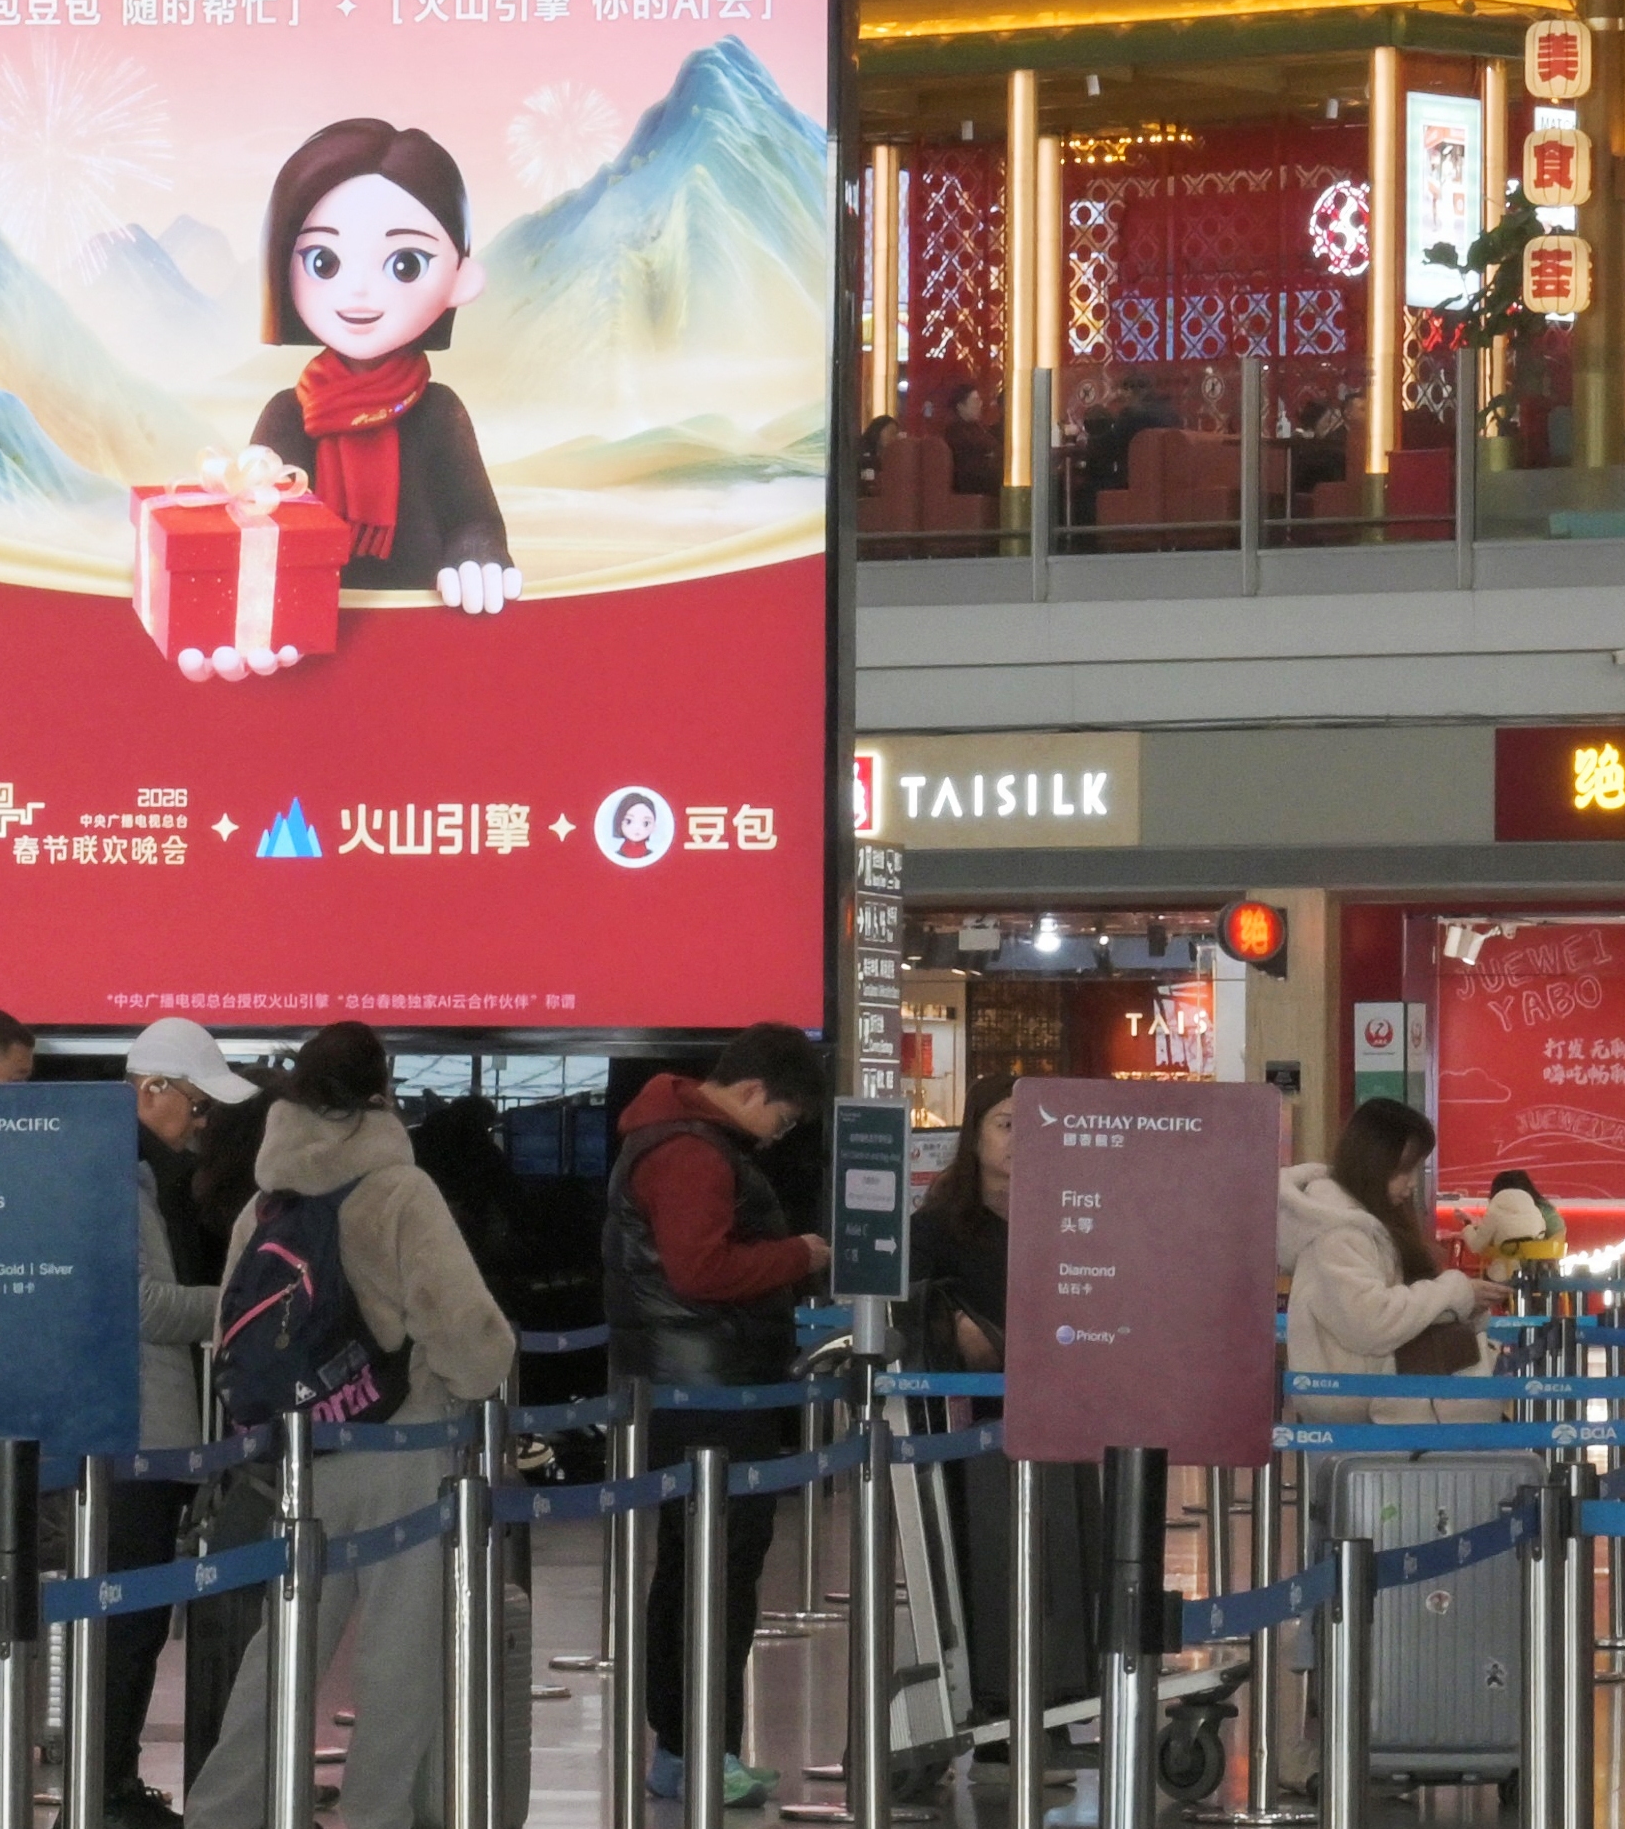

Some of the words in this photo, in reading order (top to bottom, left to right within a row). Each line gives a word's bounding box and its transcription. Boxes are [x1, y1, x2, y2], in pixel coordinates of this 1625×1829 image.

[138, 789, 187, 807] 2026
[900, 772, 1108, 819] TAISILK
[339, 804, 529, 854] 火山引擎
[684, 804, 777, 850] 豆包
[13, 835, 187, 864] 春节联欢晚会
[1456, 929, 1613, 1001] JUEWEI
[1488, 974, 1603, 1032] YABO
[1063, 1114, 1133, 1130] CATHAY
[1137, 1116, 1202, 1132] PACIFIC
[1061, 1190, 1101, 1208] First
[39, 1262, 74, 1276] Silver
[1059, 1262, 1116, 1277] Diamond
[1076, 1328, 1115, 1344] Priority
[1311, 1379, 1340, 1389] BCIA
[1544, 1383, 1572, 1393] BCIA
[1296, 1431, 1333, 1443] BCIA
[1580, 1426, 1618, 1439] BCIA
